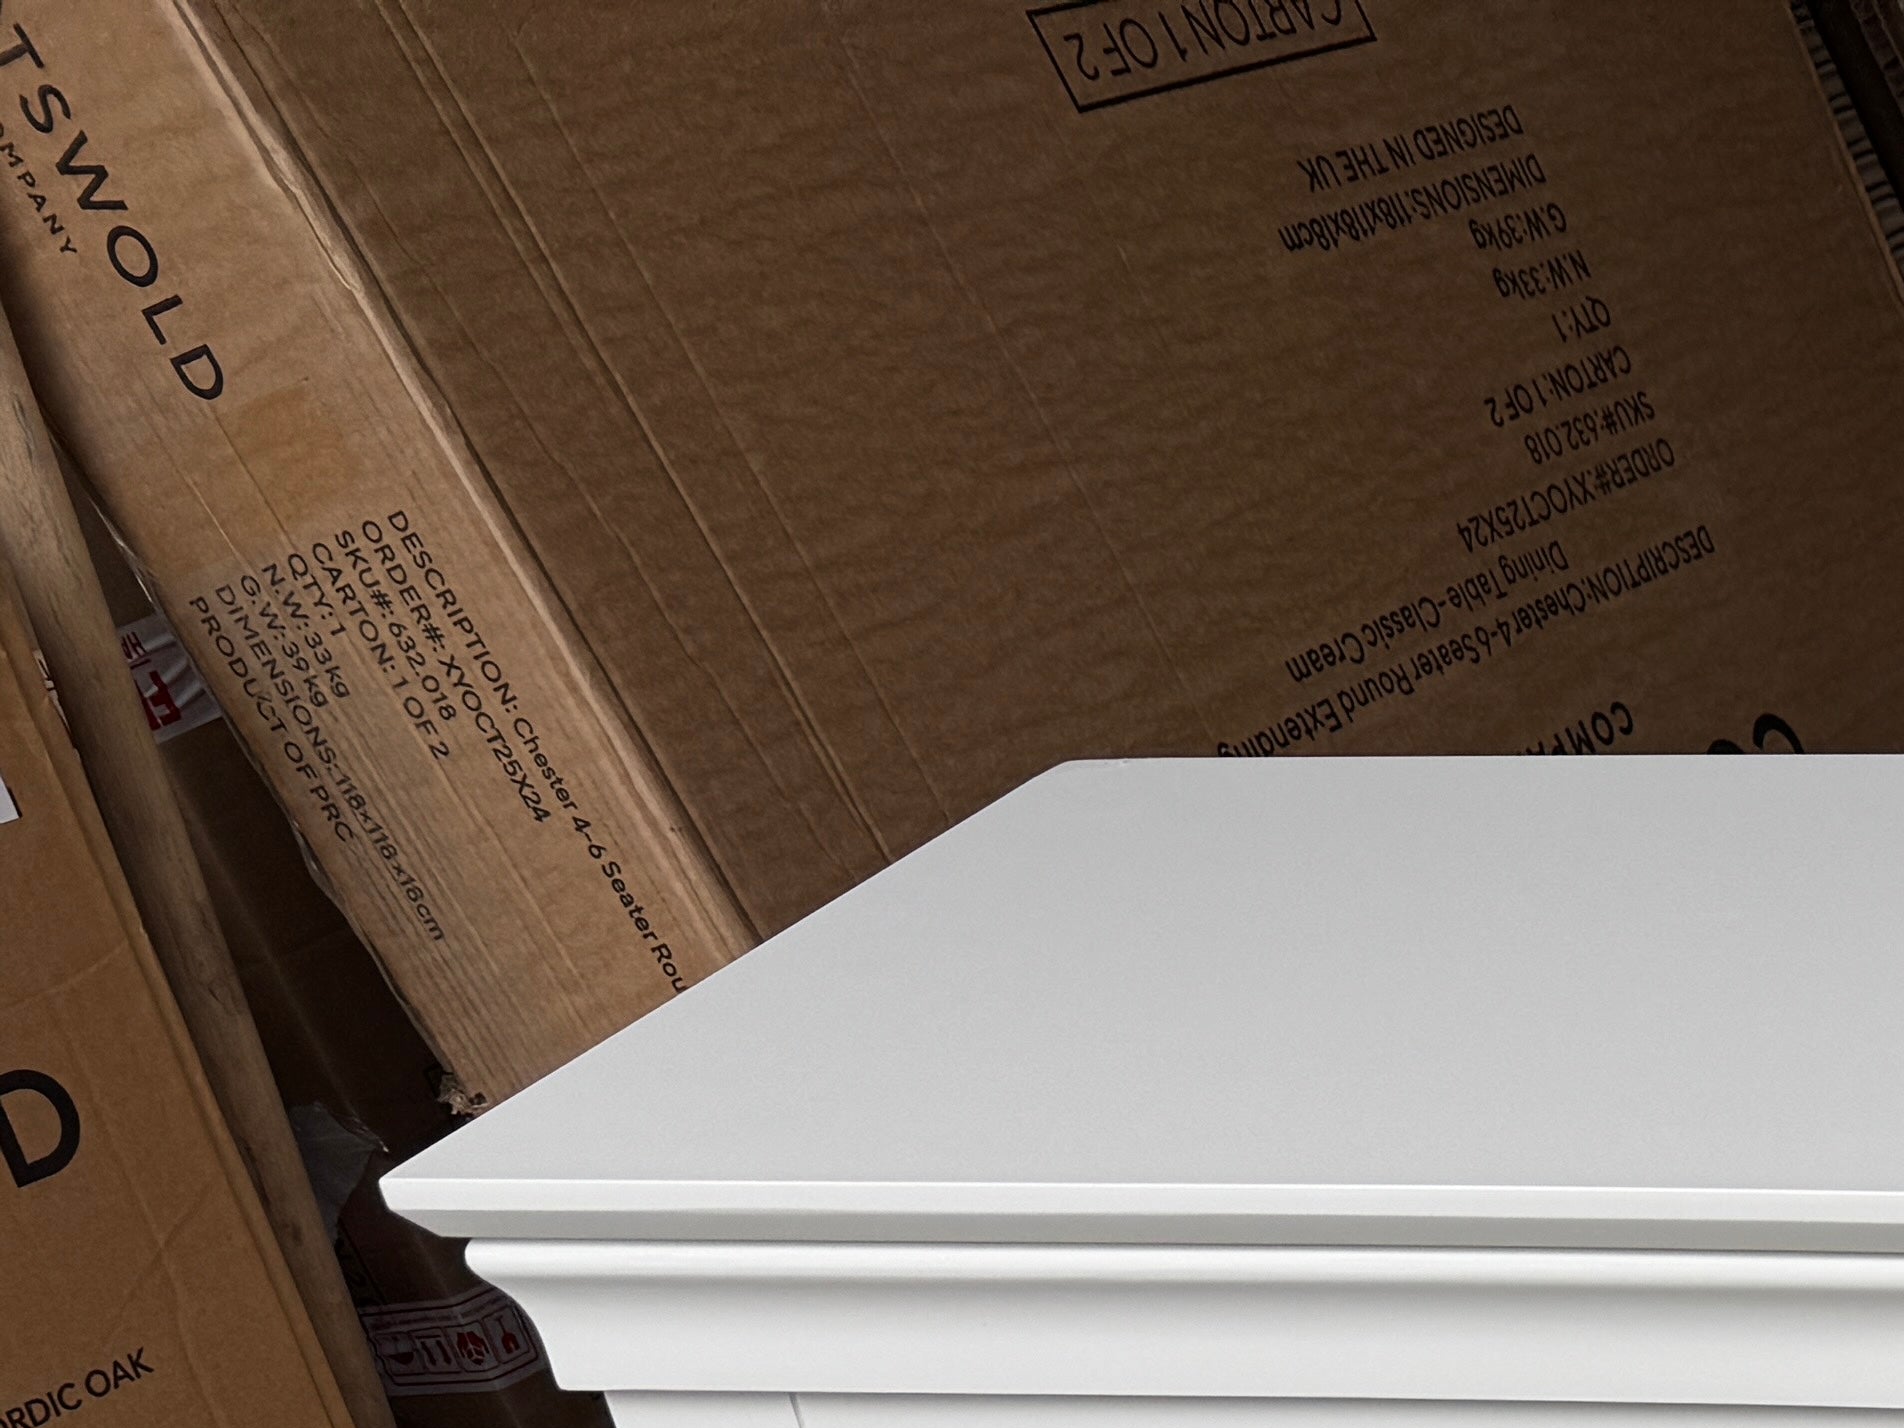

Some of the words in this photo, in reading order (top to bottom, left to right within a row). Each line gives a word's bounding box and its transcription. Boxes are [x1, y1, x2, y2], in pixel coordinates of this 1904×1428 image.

[1062, 31, 1100, 81] 2
[1101, 16, 1158, 77] OF
[1156, 10, 1188, 62] 1
[1381, 133, 1416, 170] IN
[1411, 103, 1523, 160] DESIGNED
[0, 122, 77, 256] MPANY
[1295, 154, 1341, 193] UK
[1338, 142, 1389, 183] THE
[1482, 395, 1504, 428] 2
[1503, 383, 1534, 421] OF
[1496, 539, 1569, 585] Dining
[286, 552, 334, 620] QTY:
[329, 621, 347, 637] 1
[239, 574, 286, 641] G.W:
[301, 674, 329, 708] kg
[260, 562, 310, 631] N.W:
[323, 665, 350, 698] kg
[311, 542, 395, 673] CARTON:
[390, 675, 410, 691] 1
[402, 695, 439, 736] OF
[427, 740, 450, 761] 2
[333, 529, 394, 619] SKU#:
[387, 621, 456, 721] 632.018
[1473, 617, 1511, 656] 4-6
[214, 583, 340, 776] DIMENSIONS:
[361, 520, 445, 653] ORDER#:
[436, 653, 551, 823] XYOCT25X24
[1284, 631, 1365, 683] Cream
[1408, 632, 1480, 681] Seater
[188, 595, 288, 733] PRODUCT
[283, 740, 318, 780] OF
[308, 783, 360, 843] PRC
[1335, 662, 1415, 722] Round
[386, 509, 518, 714] DESCRIPTION:
[512, 717, 578, 810] Chester
[571, 815, 607, 859] 4-6
[600, 860, 658, 941] Seater
[84, 1347, 154, 1399] OAK
